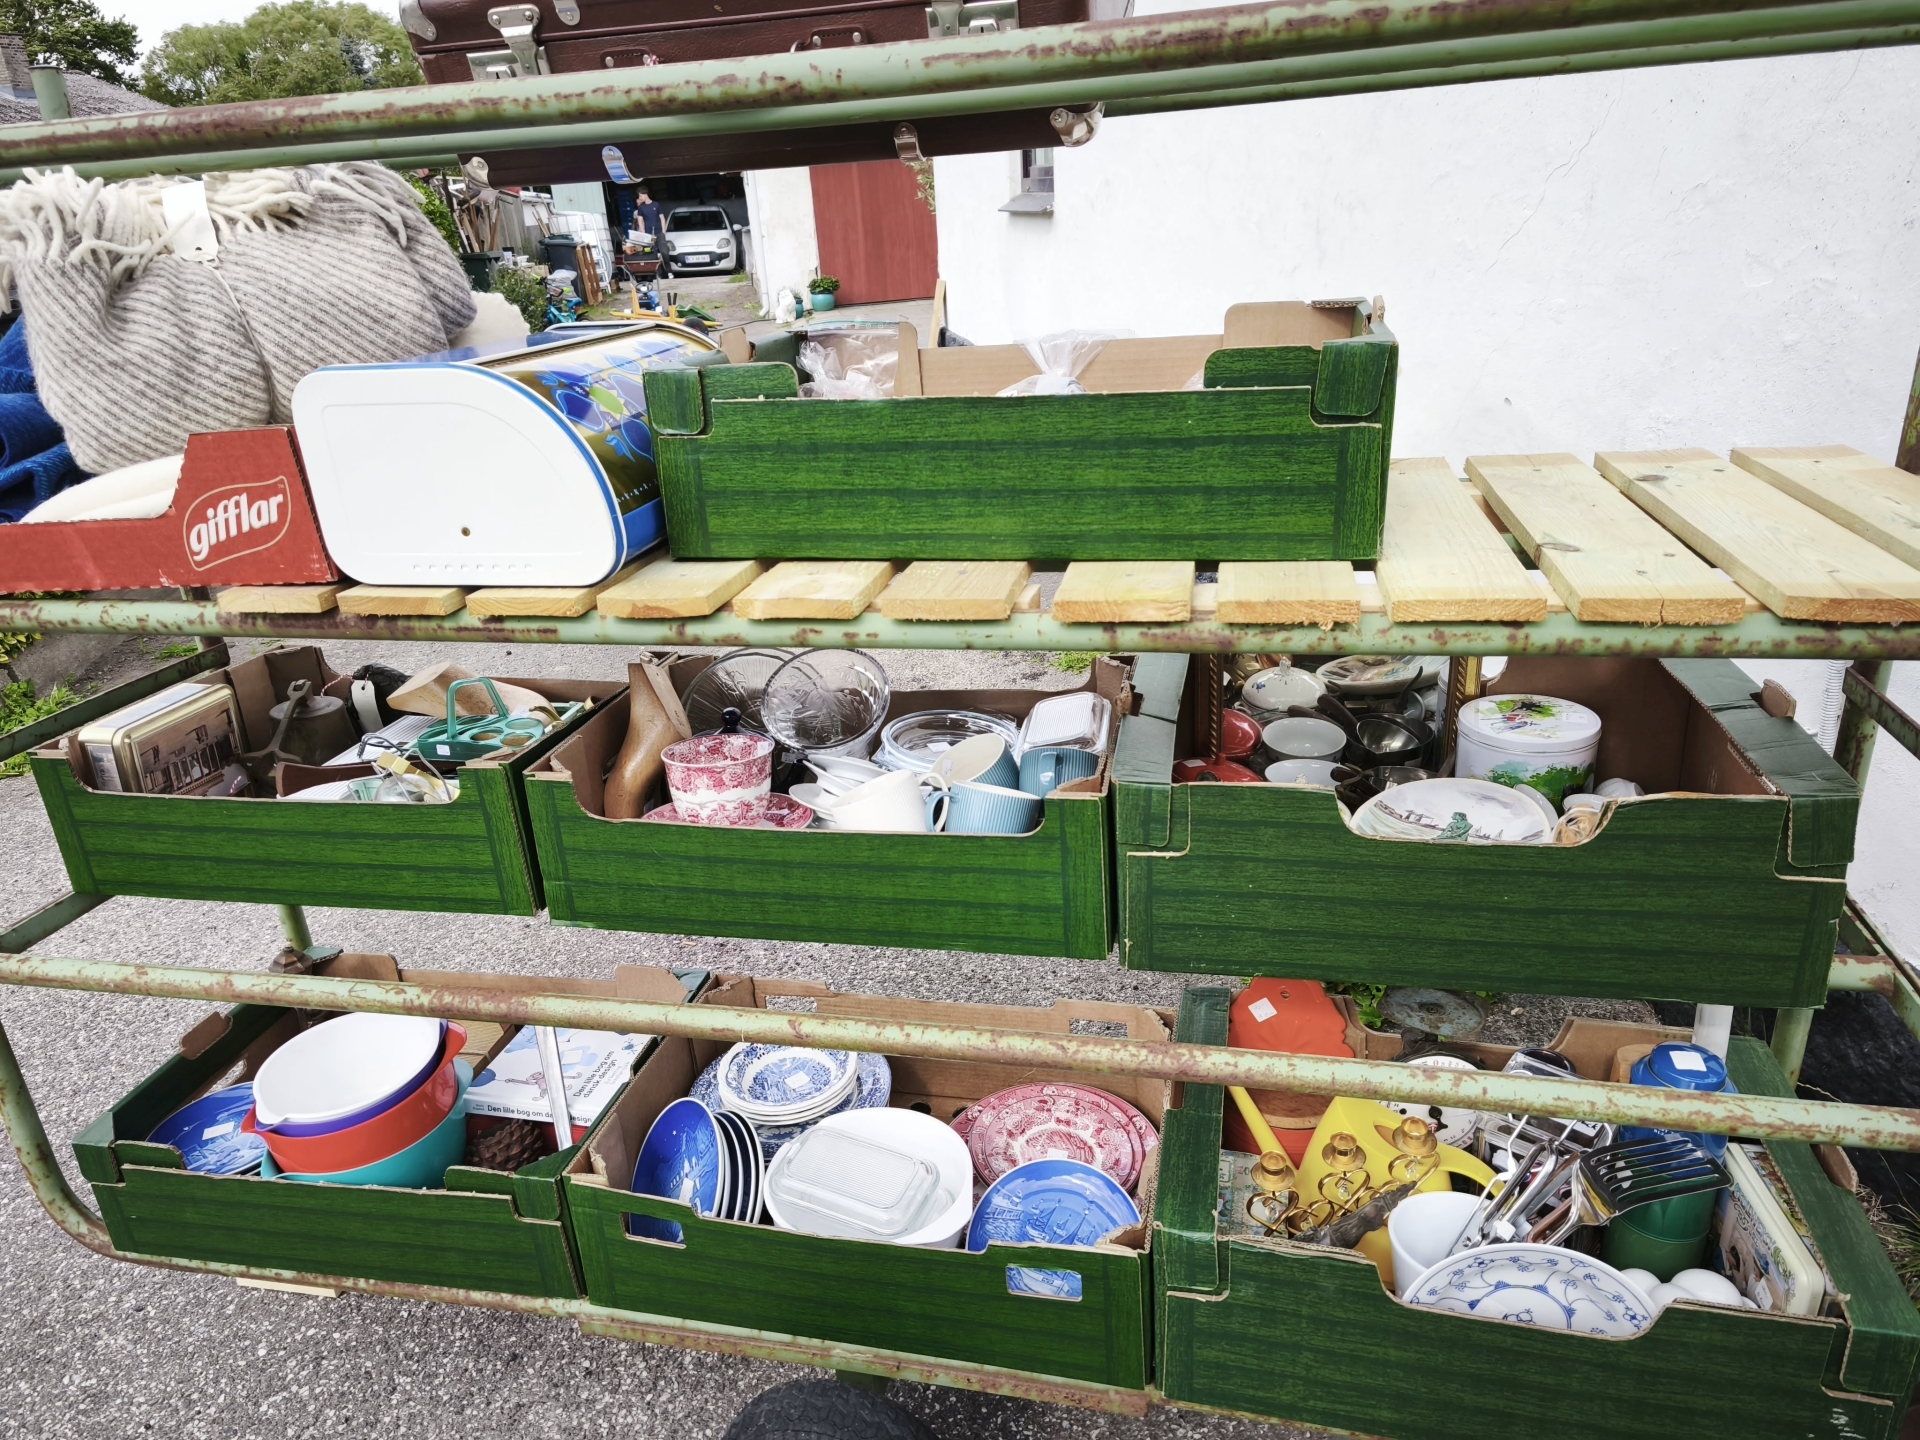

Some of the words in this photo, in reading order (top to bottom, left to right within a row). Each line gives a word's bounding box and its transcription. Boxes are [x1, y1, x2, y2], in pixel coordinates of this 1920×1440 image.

[190, 492, 284, 562] gifflar
[573, 1083, 588, 1097] Den
[584, 1079, 600, 1098] dansk
[599, 1059, 617, 1079] design
[487, 1105, 502, 1113] Den
[502, 1107, 515, 1115] lille
[516, 1108, 531, 1118] bog
